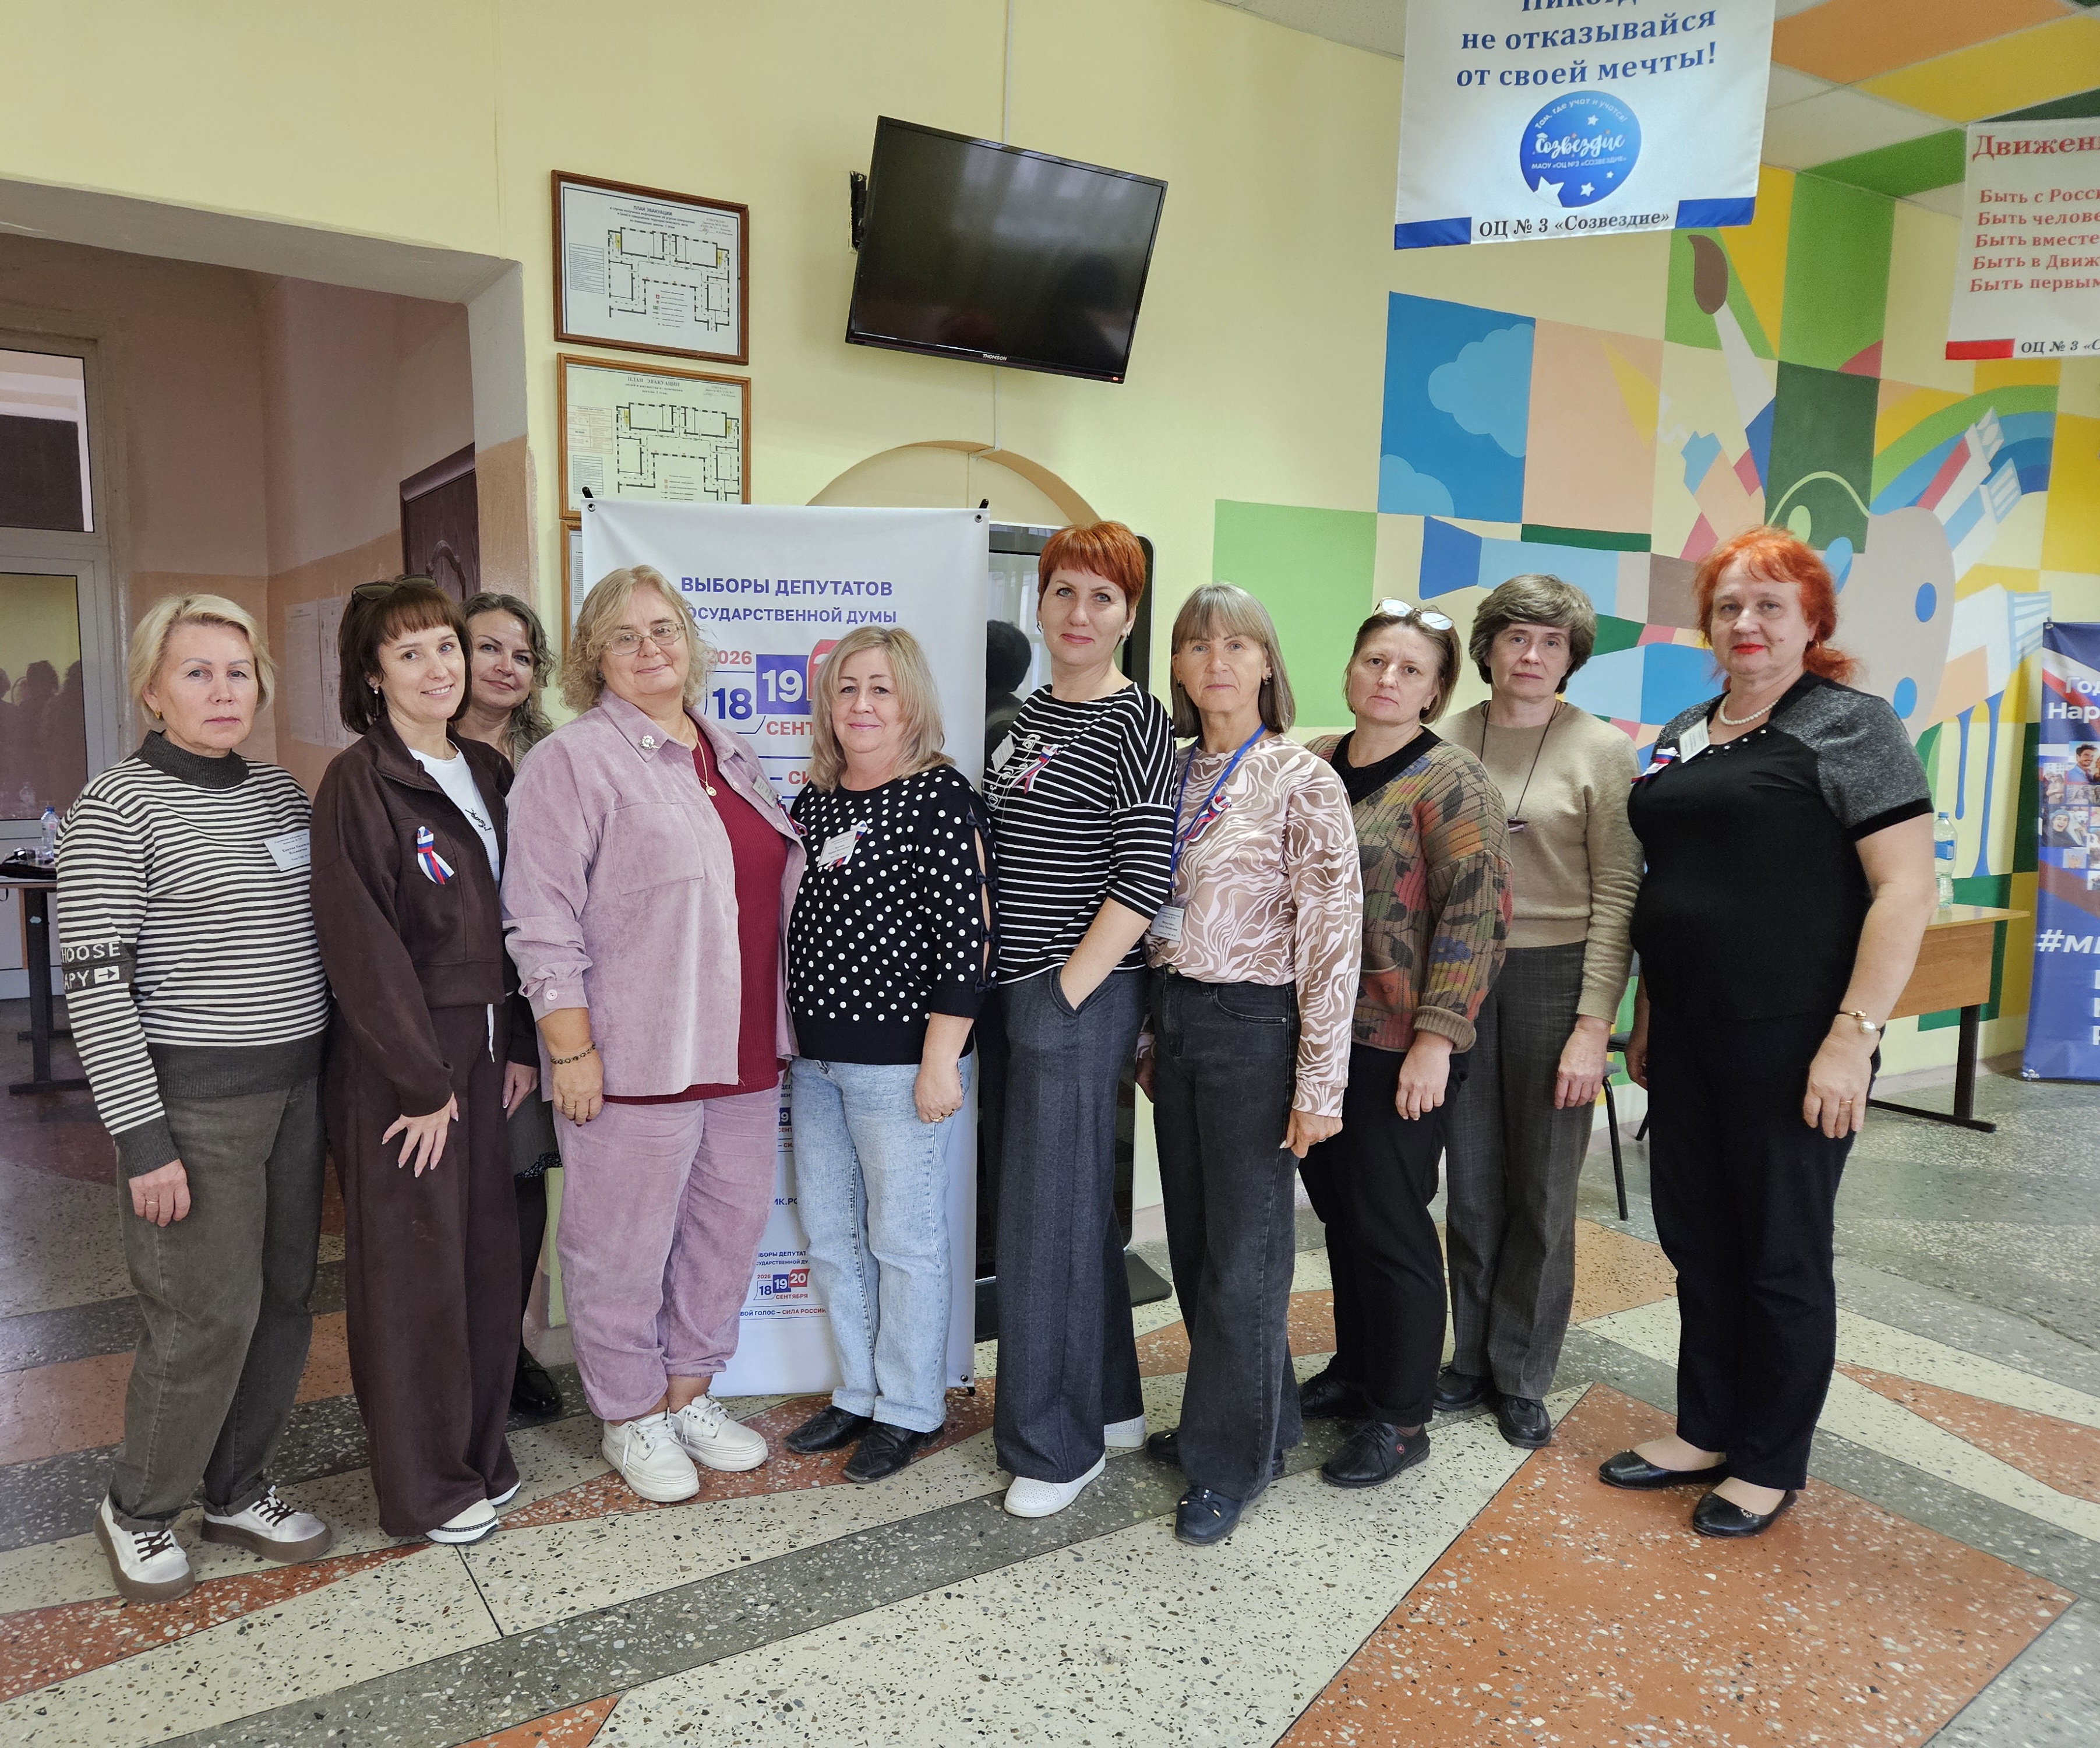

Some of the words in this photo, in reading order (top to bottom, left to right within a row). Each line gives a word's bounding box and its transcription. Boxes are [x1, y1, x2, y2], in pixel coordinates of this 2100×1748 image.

[1461, 33, 1496, 50] не
[1506, 9, 1717, 50] отказывайся
[1456, 69, 1490, 86] от
[1499, 59, 1587, 86] своей
[1598, 41, 1717, 81] мечты!
[1552, 103, 1567, 114] где
[1569, 98, 1590, 108] учат
[1535, 134, 1625, 159] Созвездие
[1972, 135, 2100, 162] Движен
[1979, 189, 2028, 203] Быть
[2034, 193, 2043, 203] с
[1480, 221, 1509, 238] ОЦ
[1513, 218, 1532, 234] №
[1538, 218, 1548, 232] 3
[1555, 213, 1670, 231] «Созвездие»
[1978, 212, 2027, 225] Быть
[1975, 234, 2027, 248] Быть
[2032, 234, 2100, 246] вместе
[1973, 256, 2025, 270] Быть
[2031, 258, 2041, 267] в
[1970, 278, 2024, 292] Быть
[2021, 341, 2046, 355] ОЦ
[2049, 340, 2066, 352] №
[2070, 340, 2078, 350] 3
[681, 577, 769, 594] ВЫБОРЫ
[775, 579, 893, 597] ДЕПУТАТОВ
[687, 607, 842, 623] ОСУДАРСТВЕННОЙ
[846, 611, 897, 625] ДУМЫ
[762, 669, 803, 703] 19
[712, 688, 753, 720] 18
[781, 1112, 789, 1122] 9
[774, 1278, 788, 1289] 19
[790, 1273, 806, 1284] 20
[759, 1285, 772, 1296] 18
